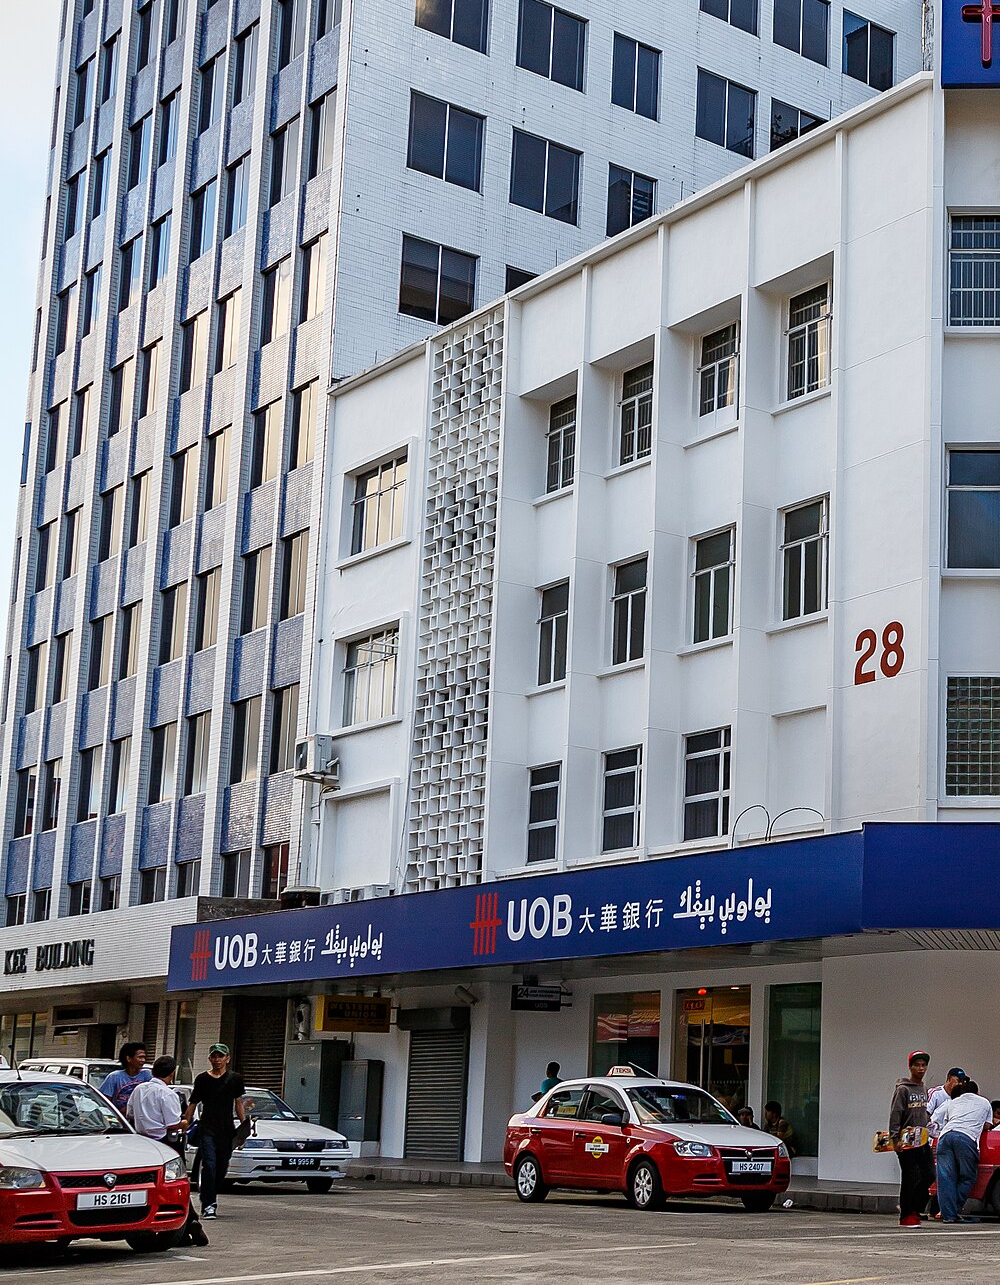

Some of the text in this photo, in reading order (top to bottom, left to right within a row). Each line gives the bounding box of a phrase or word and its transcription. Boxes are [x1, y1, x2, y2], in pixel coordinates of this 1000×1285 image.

[853, 620, 905, 686] 28
[507, 894, 573, 941] UOB
[579, 899, 664, 934] 大華銀行
[3, 939, 95, 975] KEE BUILDING
[214, 932, 258, 970] UOB
[260, 938, 316, 965] 大華銀行
[329, 1002, 376, 1011] WESTERN
[344, 1010, 376, 1018] UNION
[739, 1163, 764, 1171] HS 2407
[93, 1192, 132, 1206] HS 2161
